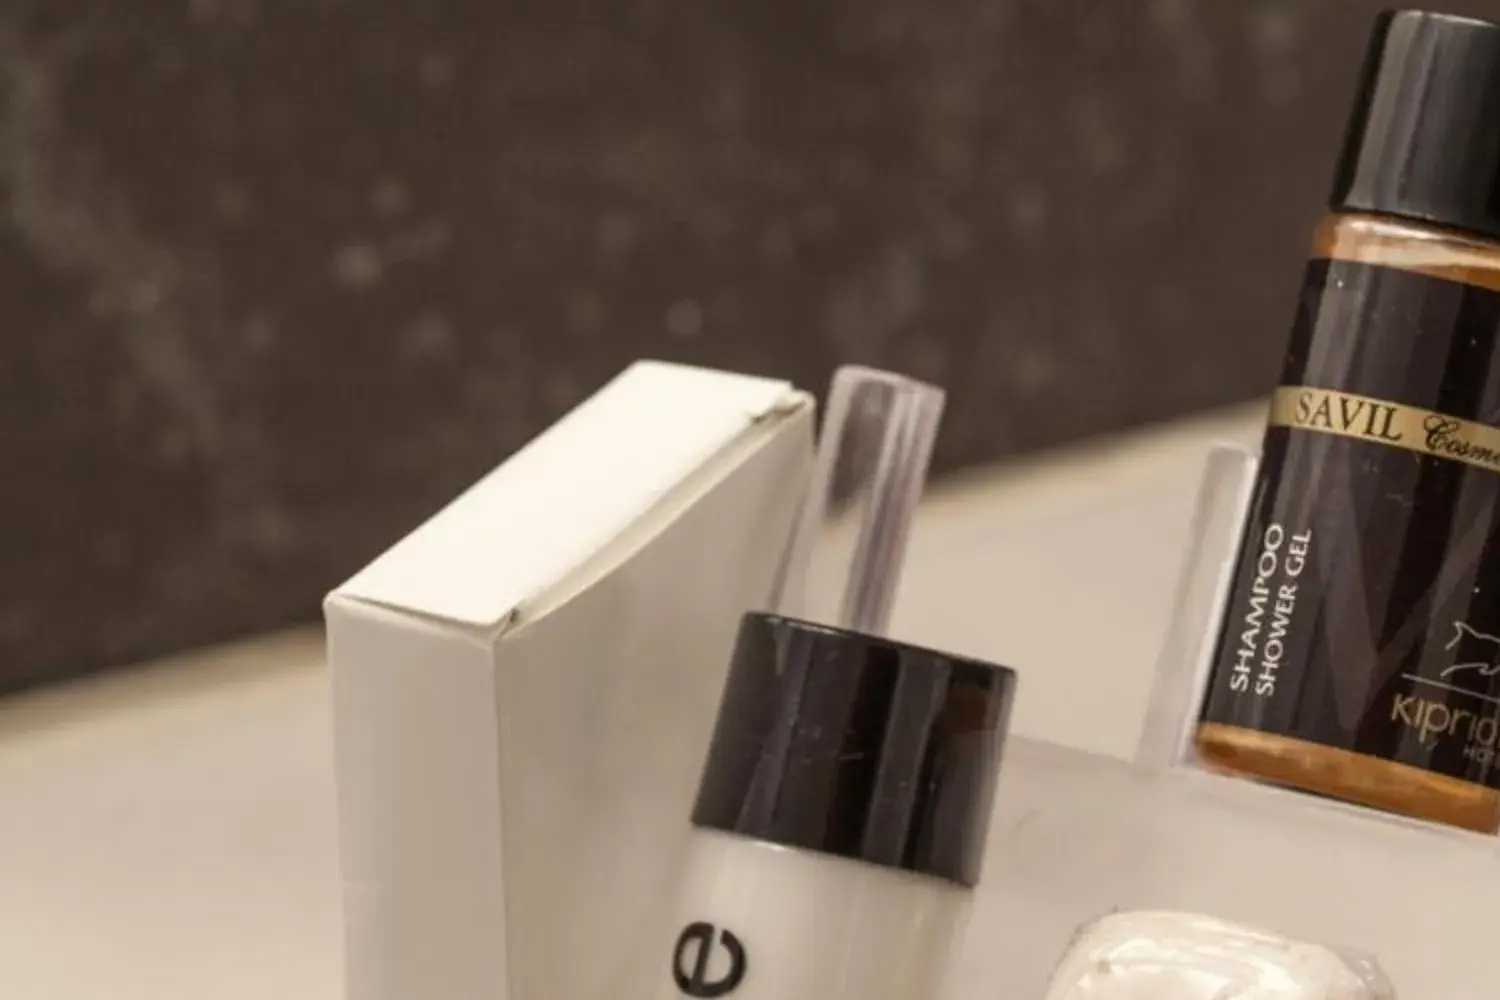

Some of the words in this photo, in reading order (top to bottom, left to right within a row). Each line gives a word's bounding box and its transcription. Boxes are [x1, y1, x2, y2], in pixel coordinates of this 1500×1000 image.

[1294, 391, 1404, 442] SAVIL
[1229, 523, 1285, 694] SHAMPOO
[1255, 585, 1298, 697] SHOWER
[1283, 528, 1312, 578] GEL
